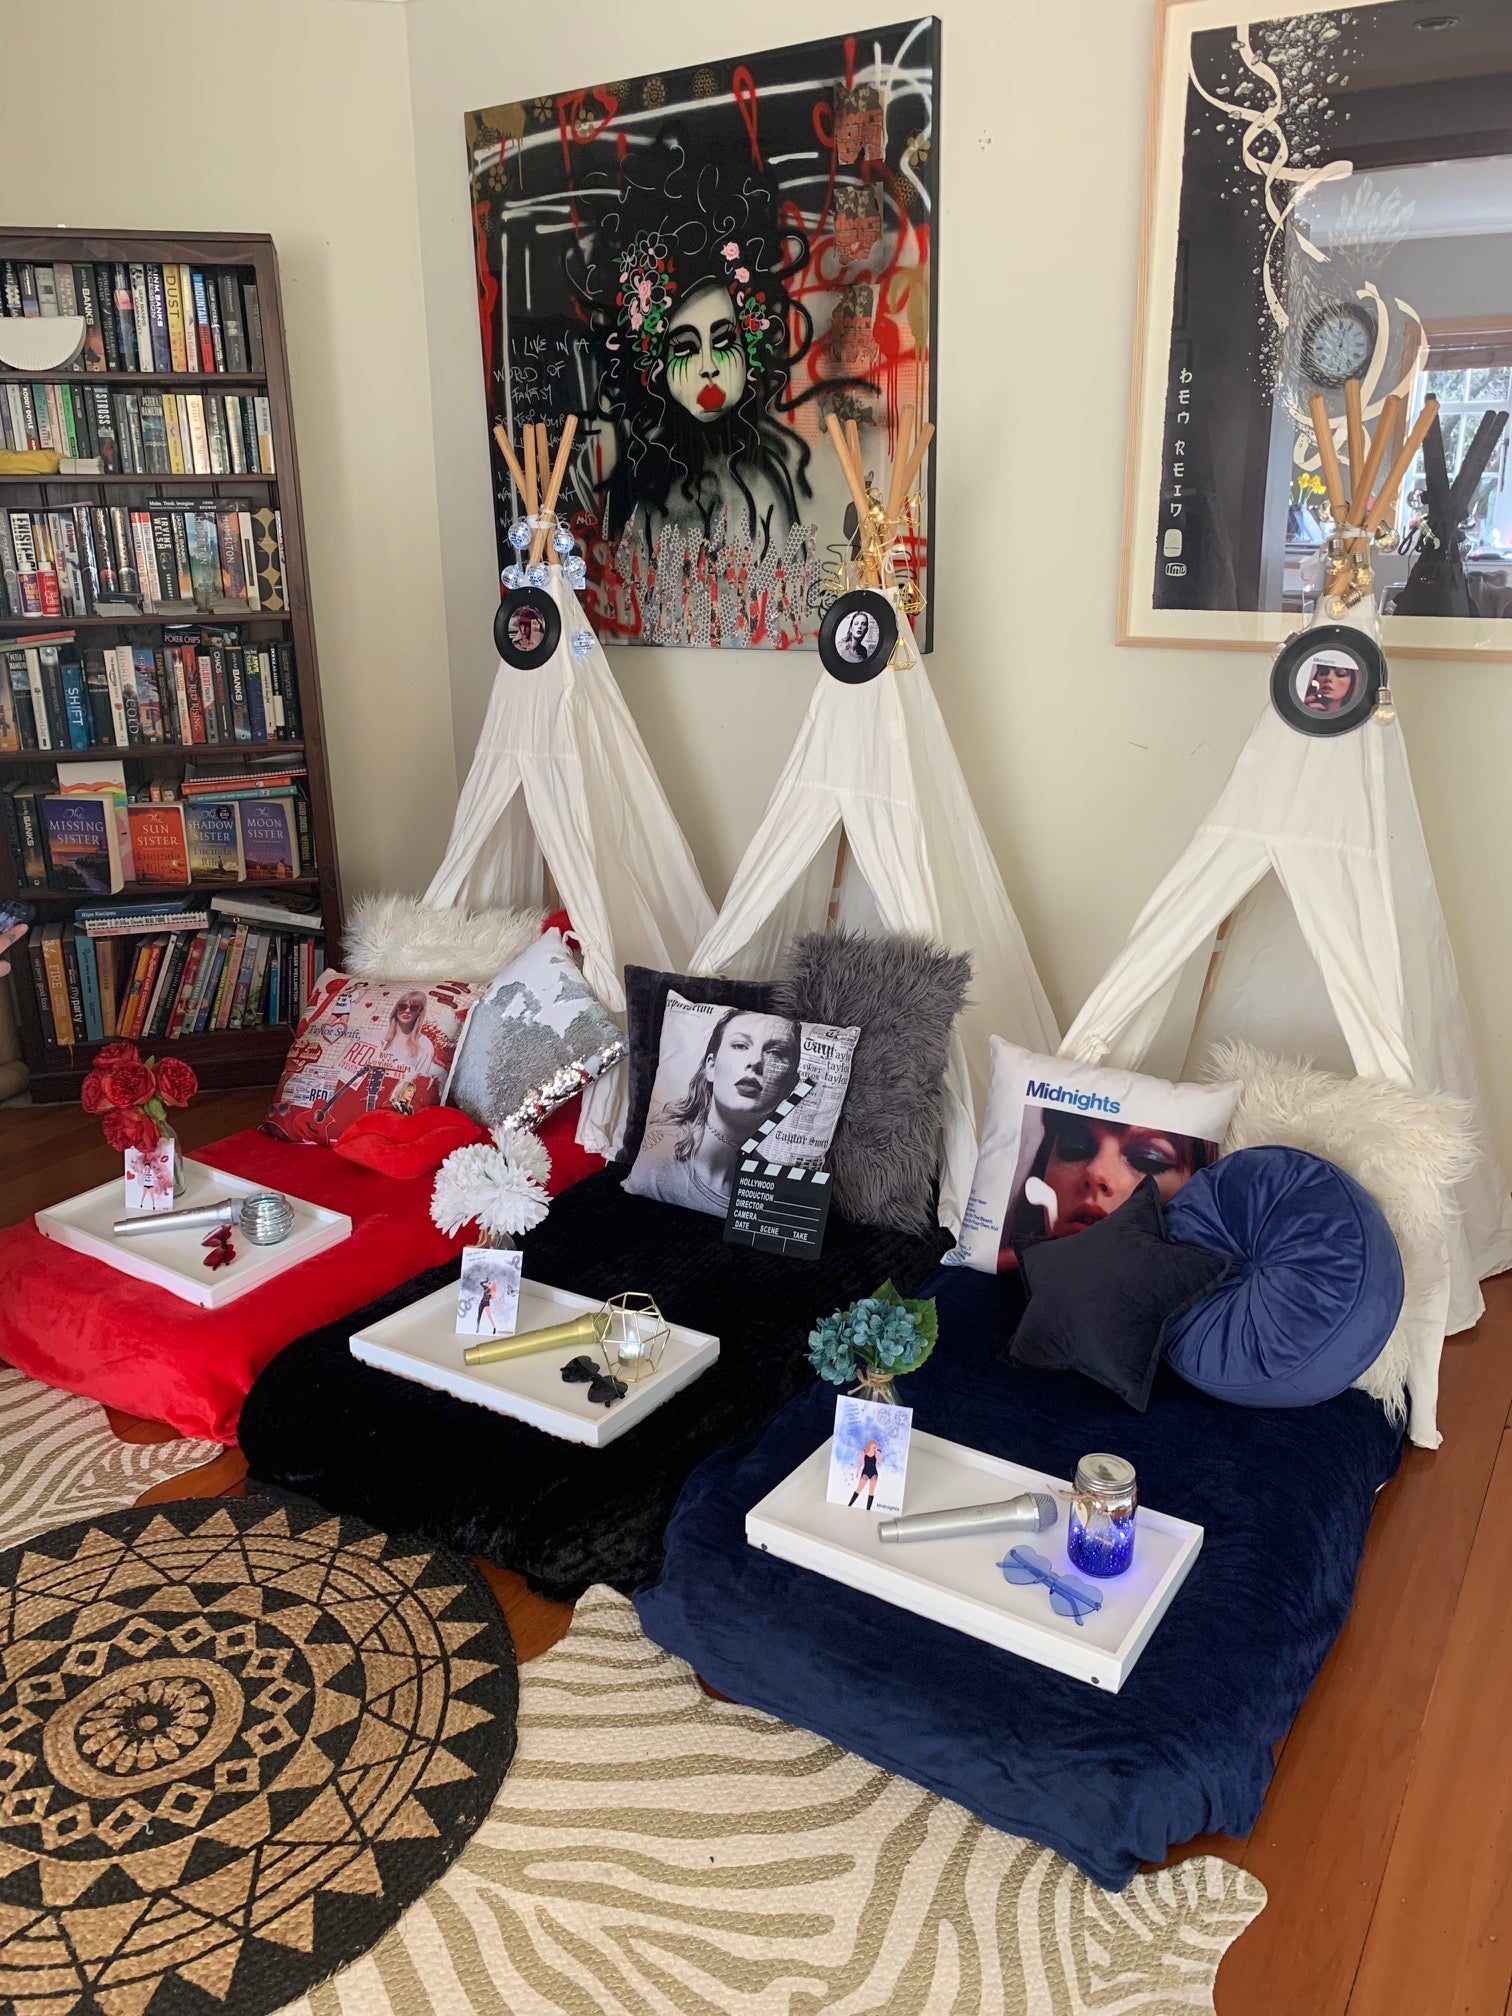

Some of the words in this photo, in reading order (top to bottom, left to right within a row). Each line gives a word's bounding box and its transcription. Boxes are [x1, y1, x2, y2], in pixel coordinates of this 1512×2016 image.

[81, 288, 94, 325] BANKS
[165, 275, 180, 318] DUST
[193, 283, 208, 324] MOUNTAIN
[156, 294, 164, 327] BANKS
[511, 339, 517, 354] I
[524, 335, 547, 359] LIVE
[556, 330, 569, 355] IN
[494, 367, 538, 383] WORLD
[547, 361, 566, 378] OF
[511, 384, 553, 405] FANTASY
[22, 387, 30, 409] RODDY
[26, 410, 34, 429] DOYLE
[95, 394, 110, 425] STROSS
[154, 517, 164, 549] WELSH
[160, 517, 171, 549] IRVINE
[165, 635, 182, 643] POKER
[184, 636, 200, 644] CHIPS
[214, 652, 222, 674] CHAOS
[188, 684, 197, 701] RED
[232, 669, 242, 701] BANKS
[68, 687, 83, 726] SHIFT
[126, 699, 139, 734] COLD
[191, 703, 202, 731] RISING
[63, 806, 84, 819] The
[22, 815, 34, 847] BANKS
[50, 820, 104, 832] MISSING
[142, 824, 169, 834] SUN
[187, 820, 233, 830] SHADOW
[247, 818, 282, 828] MOON
[57, 833, 100, 845] SISTER
[137, 836, 178, 846] SISTER
[193, 831, 231, 842] SISTER
[248, 828, 284, 839] SISTER
[49, 964, 62, 989] FIRE
[37, 983, 45, 997] good
[40, 997, 48, 1011] food
[308, 1024, 333, 1036] Taylor
[344, 1042, 376, 1067] RED
[309, 1088, 328, 1101] RED
[1026, 1080, 1121, 1114] Midnights
[739, 1178, 775, 1191] HOLLYWOOD
[735, 1199, 764, 1210] DIRECTOR
[738, 1189, 774, 1202] PRODUCTION
[733, 1210, 757, 1221] CAMERA
[734, 1221, 750, 1230] DATE
[760, 1225, 779, 1235] SCENE
[793, 1231, 808, 1240] TAKE
